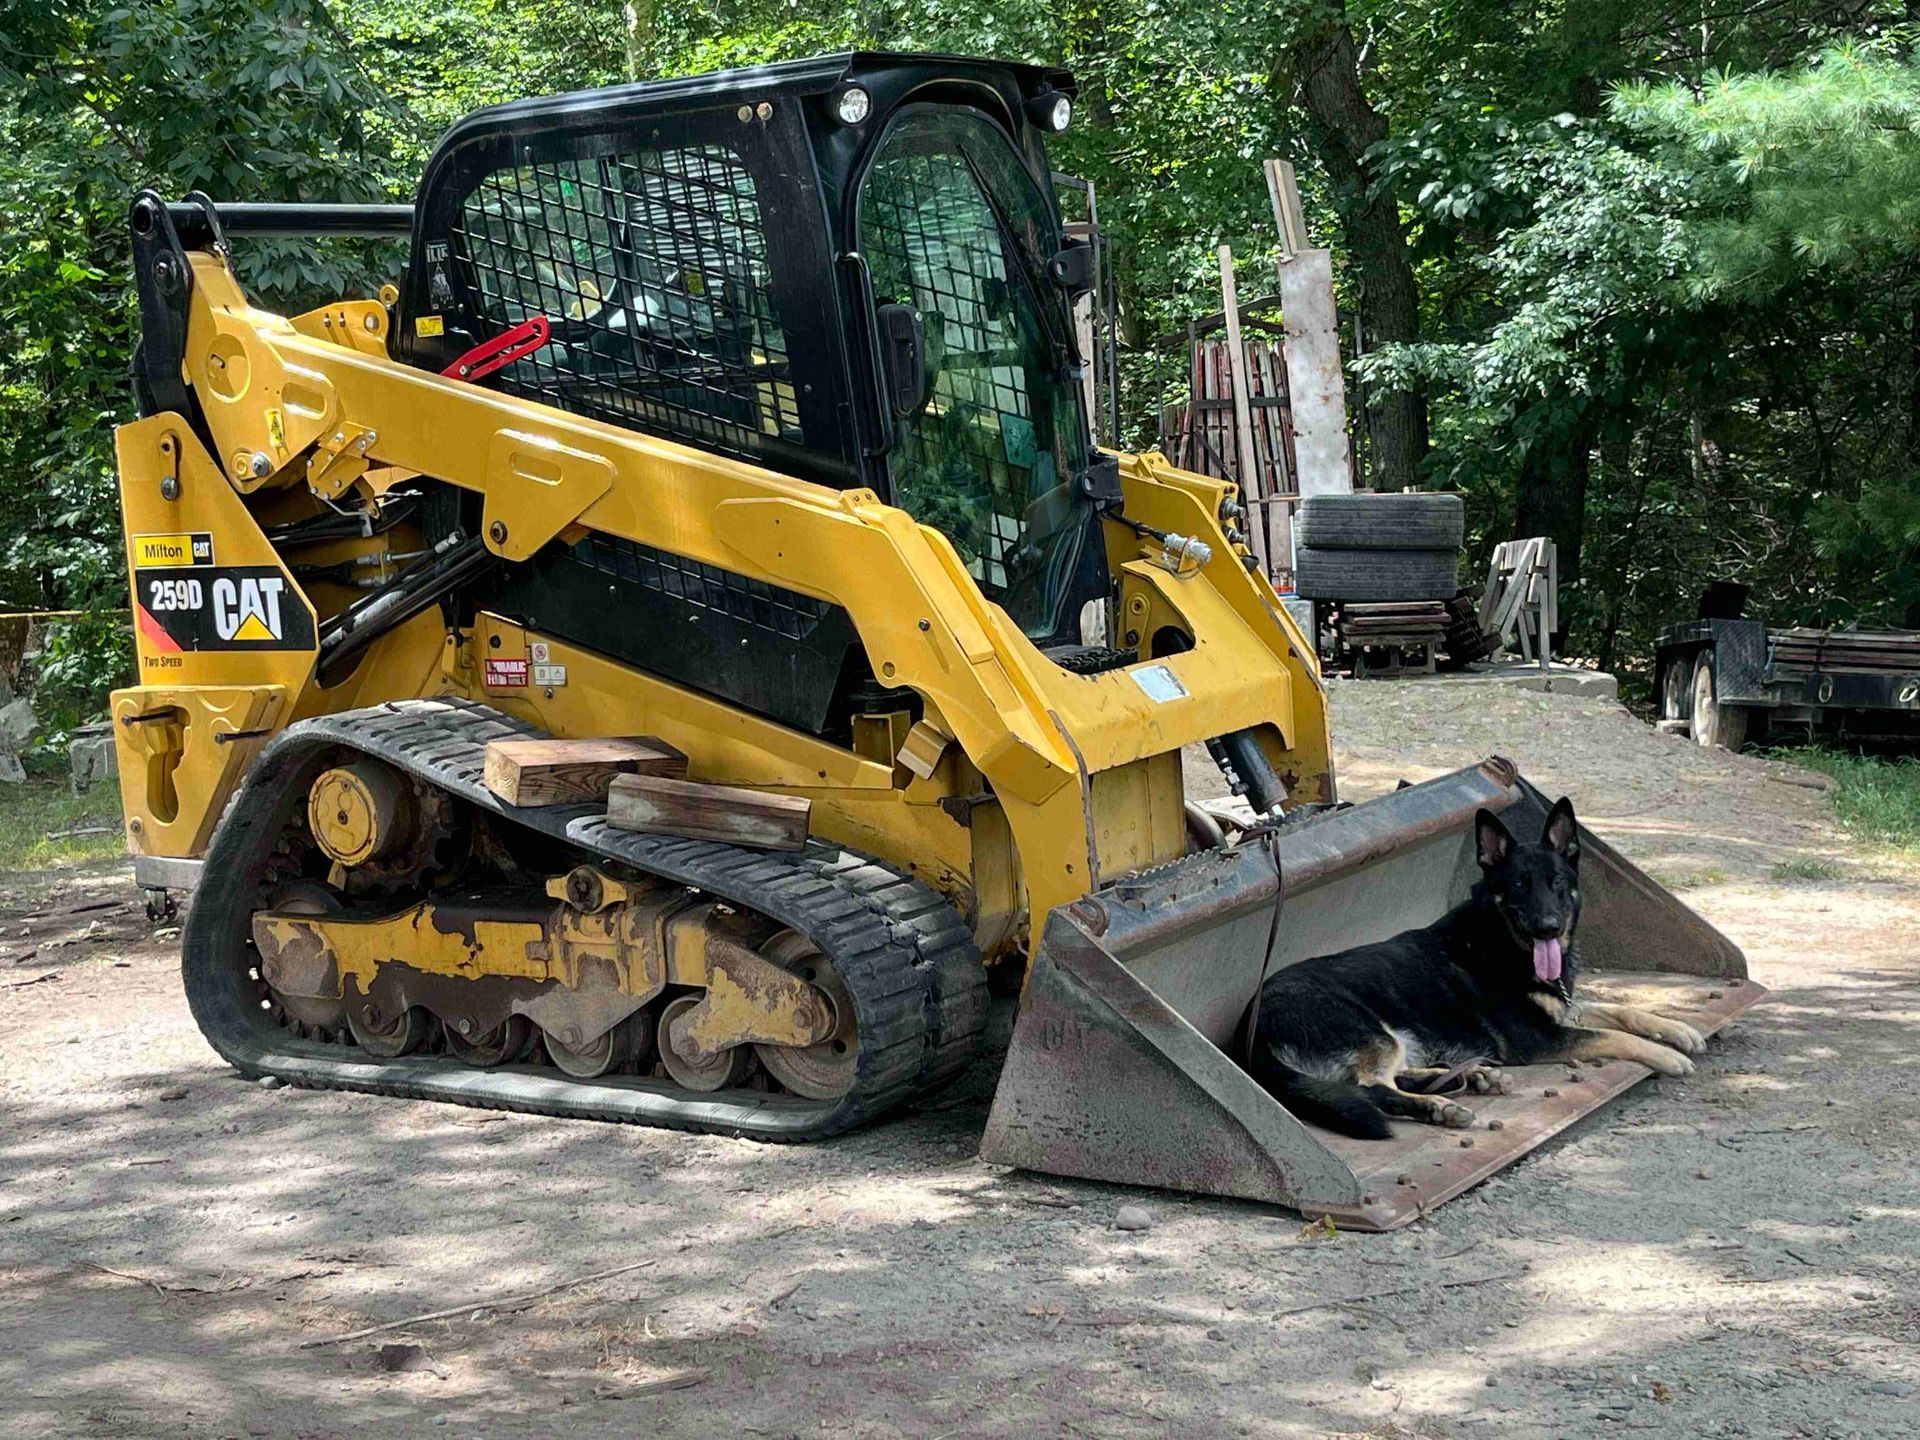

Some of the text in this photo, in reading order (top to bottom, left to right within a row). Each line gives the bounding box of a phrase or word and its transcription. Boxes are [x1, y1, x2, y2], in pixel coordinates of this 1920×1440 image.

[144, 541, 210, 559] Milton CAT
[150, 577, 284, 641] 259D CAT
